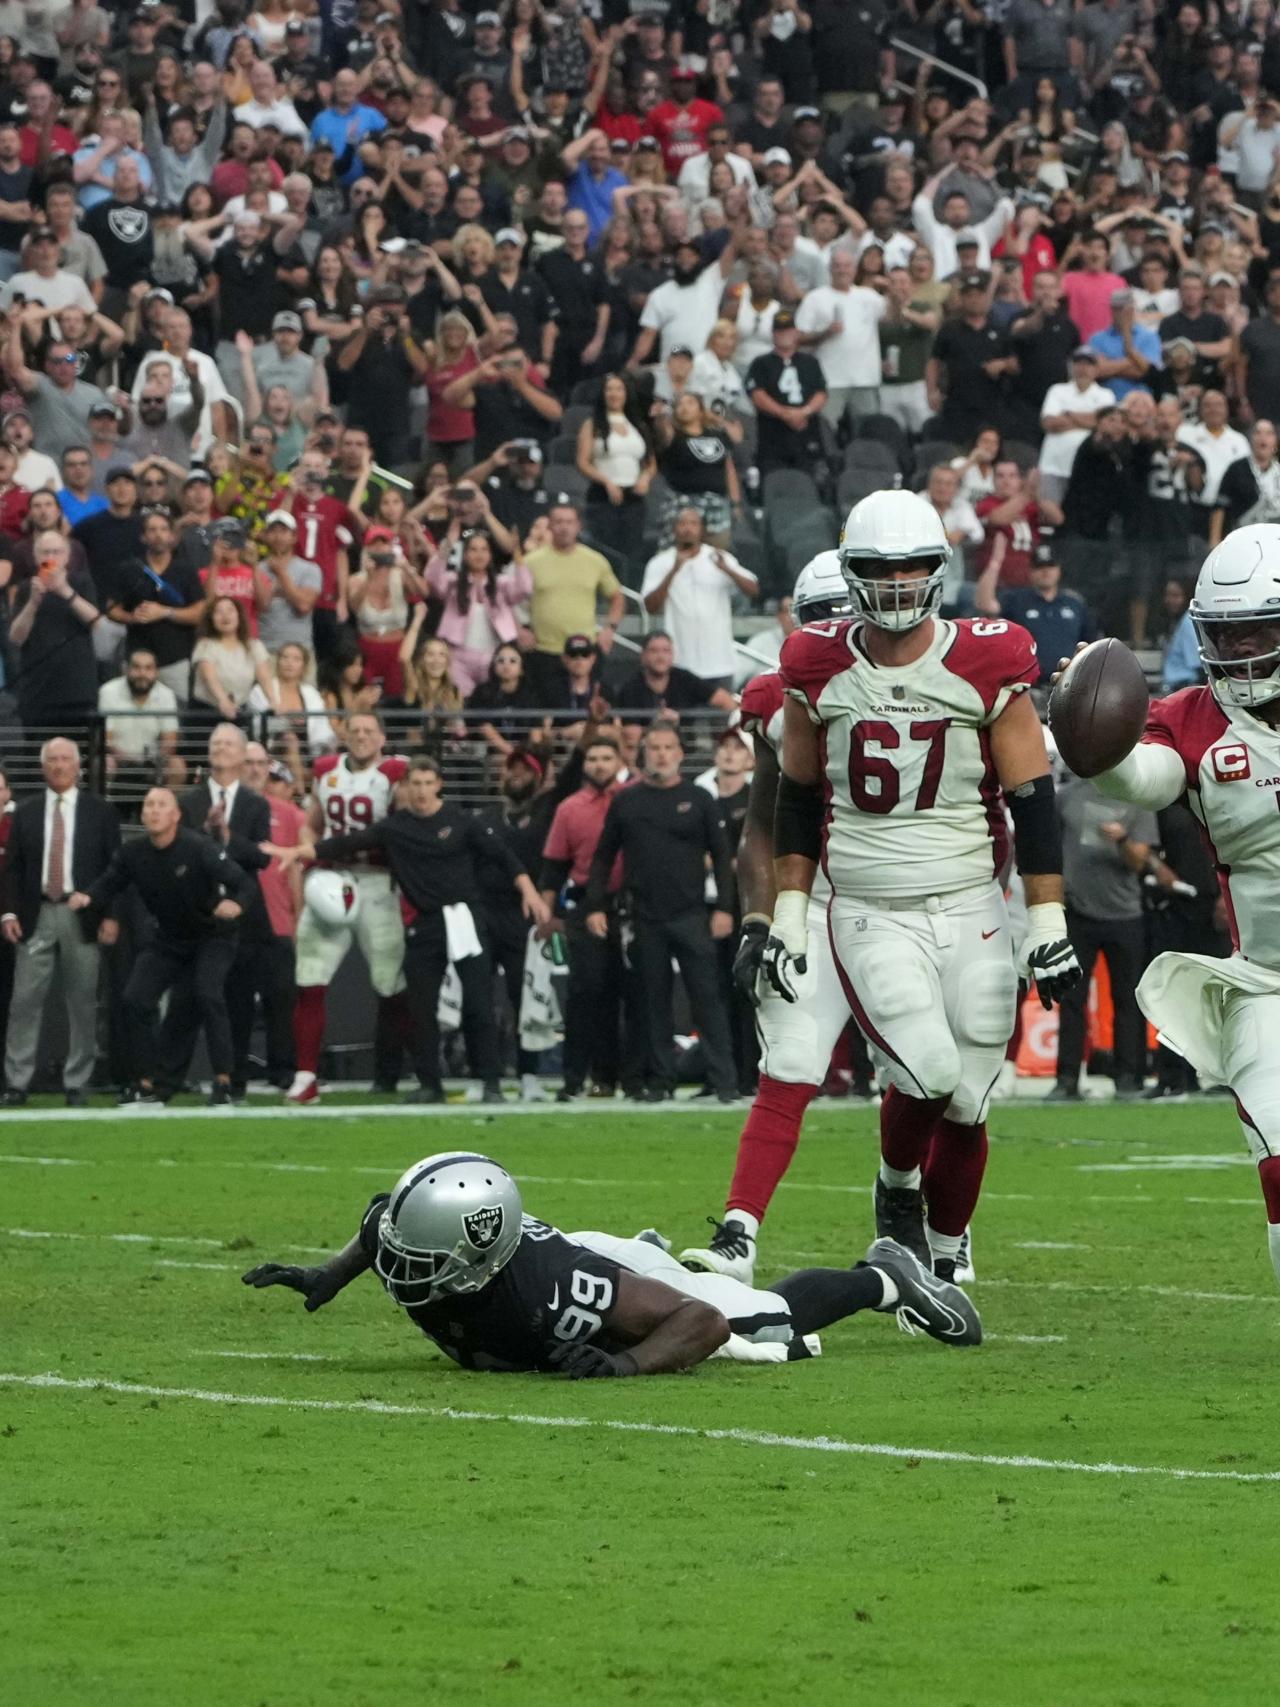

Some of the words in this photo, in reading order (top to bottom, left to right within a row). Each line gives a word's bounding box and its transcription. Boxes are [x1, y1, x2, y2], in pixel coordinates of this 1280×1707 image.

[777, 366, 804, 405] 4
[305, 518, 319, 560] 1
[971, 617, 1009, 638] 6
[869, 704, 931, 714] CARDINALS
[848, 718, 953, 815] 67
[1215, 745, 1248, 773] C
[467, 1206, 501, 1224] RAIDERS
[554, 1268, 613, 1342] 99
